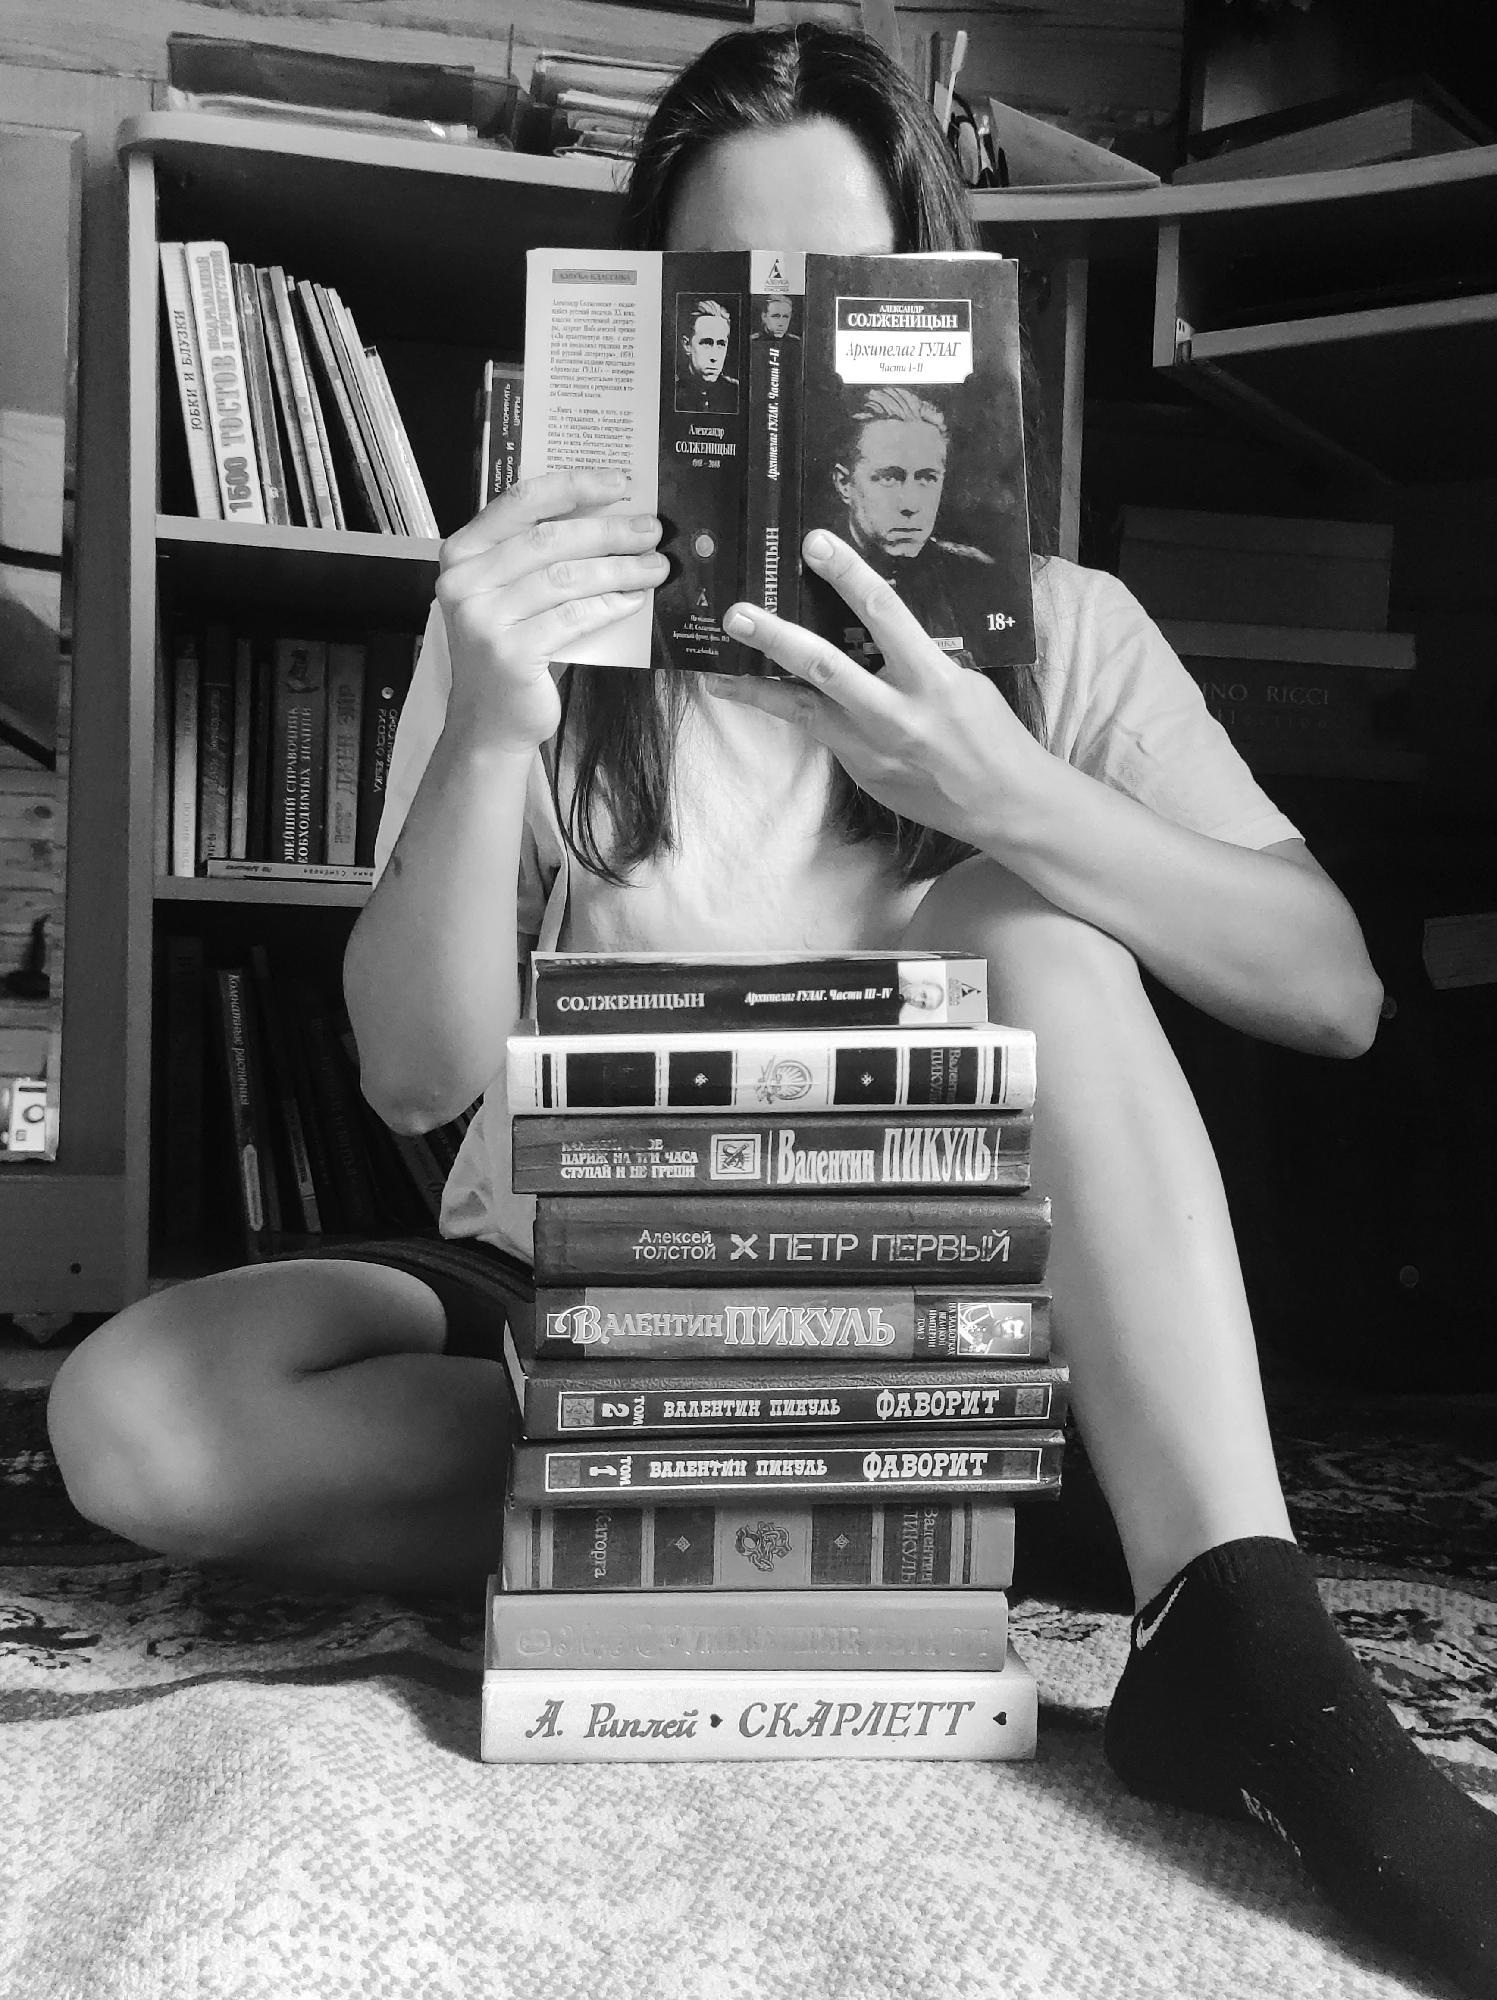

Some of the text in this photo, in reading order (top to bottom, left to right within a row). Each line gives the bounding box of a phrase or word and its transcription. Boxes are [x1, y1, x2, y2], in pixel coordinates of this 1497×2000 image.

[848, 313, 958, 330] СОЛЖЕНИЦЫН
[880, 304, 924, 313] АЛЕКСАНДР
[846, 342, 961, 360] Архипелаг ГУЛАГ
[173, 310, 204, 431] ЮБКИ И БЛУЗКИ
[880, 363, 906, 372] Части
[768, 367, 780, 399] Части
[212, 355, 254, 513] 1500 ТОСТОВ
[506, 442, 515, 451] И
[676, 441, 736, 456] СОЛЖЕНИЦЫН
[767, 433, 780, 481] Архипелаг
[986, 613, 1016, 630] 18+
[1267, 686, 1329, 705] RICCI
[300, 708, 312, 762] ЗНАНИЙ
[285, 708, 299, 793] СПРАВОЧНИК
[556, 993, 705, 1012] СОЛЖЕНИЦЫН
[744, 991, 796, 1006] Архипелаг
[796, 989, 828, 1002] ГУЛАГ.
[829, 988, 862, 1001] Части
[228, 973, 249, 1106] Комнатные растения
[561, 1152, 608, 1165] ПАРИЖ
[665, 1151, 699, 1164] ЧАСА
[777, 1128, 992, 1184] Валентин ПИКУЛЬ
[560, 1164, 696, 1179] СТУПАЙ И НЕ ГРЕШИ
[639, 1229, 712, 1245] Алексей
[769, 1229, 1011, 1262] ПЕТР ПЕРВЫЙ
[632, 1244, 716, 1260] ТОЛСТОЙ
[724, 1306, 896, 1346] ПИКУЛЬ
[917, 1318, 926, 1334] ТОМ
[928, 1309, 937, 1348] ИМПЕРИИ
[602, 1402, 630, 1418] 2
[633, 1395, 645, 1426] ТОМ
[663, 1389, 1000, 1422] ВАЛЕНТИН ПИКУЛЬ ФАВОРИТ
[589, 1465, 617, 1477] 1
[619, 1455, 632, 1486] ТОМ
[650, 1450, 988, 1482] ВАЛЕНТИН ПИКУЛЬ ФАВОРИТ
[525, 1700, 975, 1739] А. Риплей СКАРЛЕТТ
